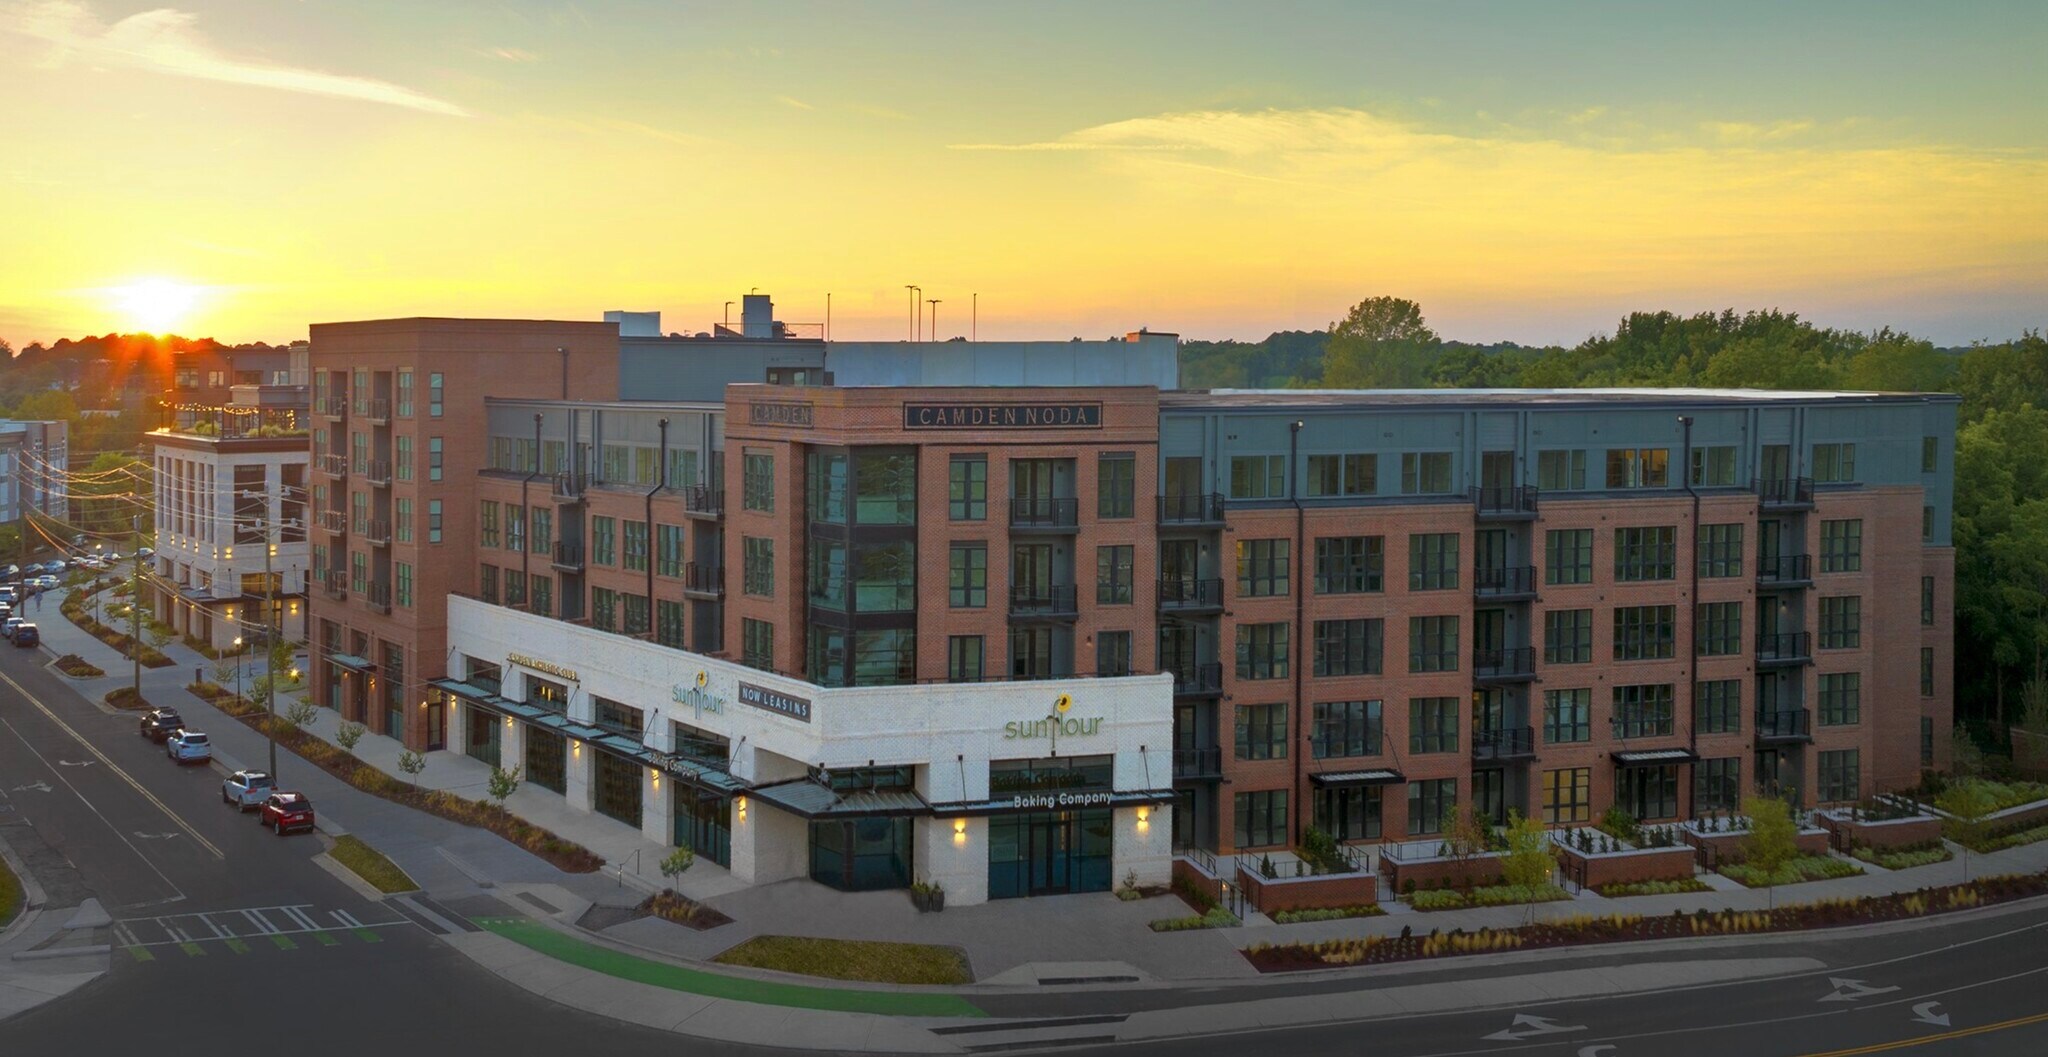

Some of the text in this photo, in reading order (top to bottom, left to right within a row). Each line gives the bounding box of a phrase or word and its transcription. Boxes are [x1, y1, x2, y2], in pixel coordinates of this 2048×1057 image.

[754, 403, 810, 424] CAMDEN
[920, 406, 1088, 425] CAMDEN NODA
[561, 667, 578, 681] CLUB
[742, 687, 761, 703] NOW
[1014, 792, 1113, 808] Baking Company
